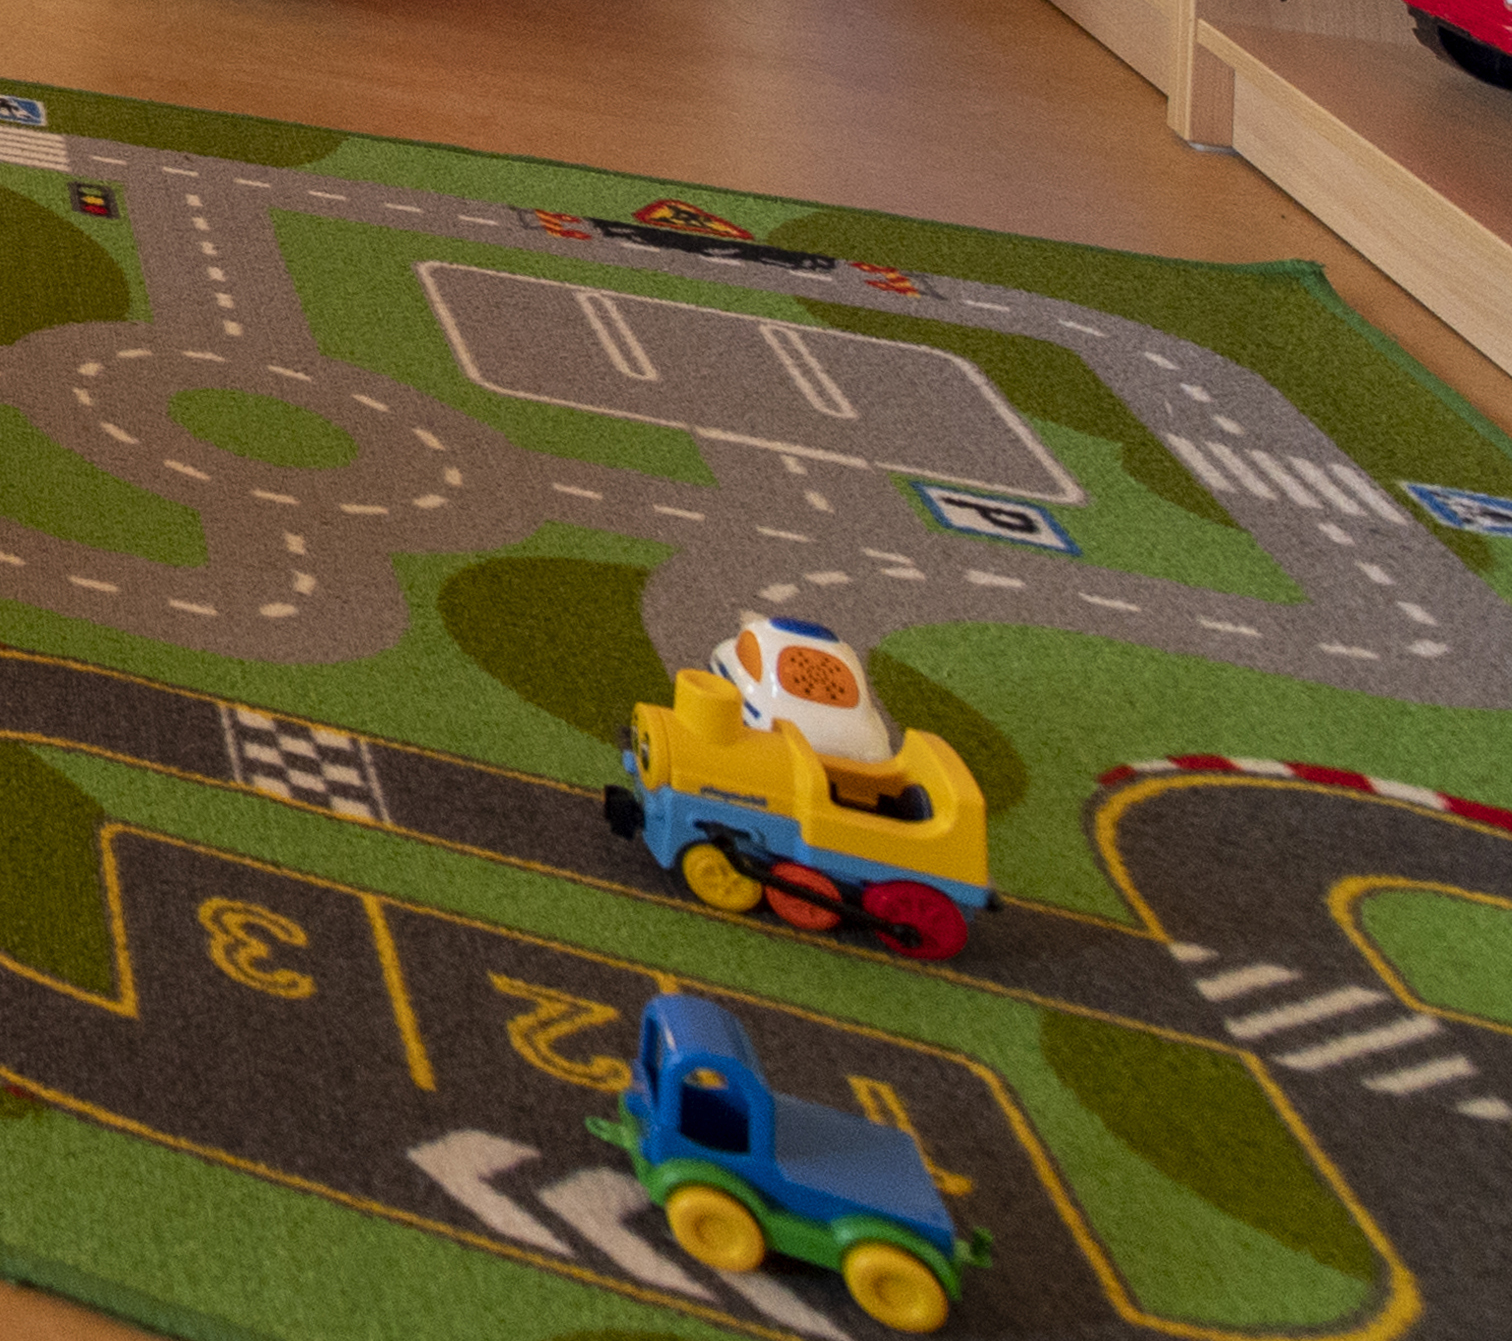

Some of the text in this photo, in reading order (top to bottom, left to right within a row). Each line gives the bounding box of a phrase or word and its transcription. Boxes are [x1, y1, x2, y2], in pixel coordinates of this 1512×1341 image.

[941, 497, 1040, 534] P
[198, 897, 317, 998] 3
[487, 970, 633, 1093] 2
